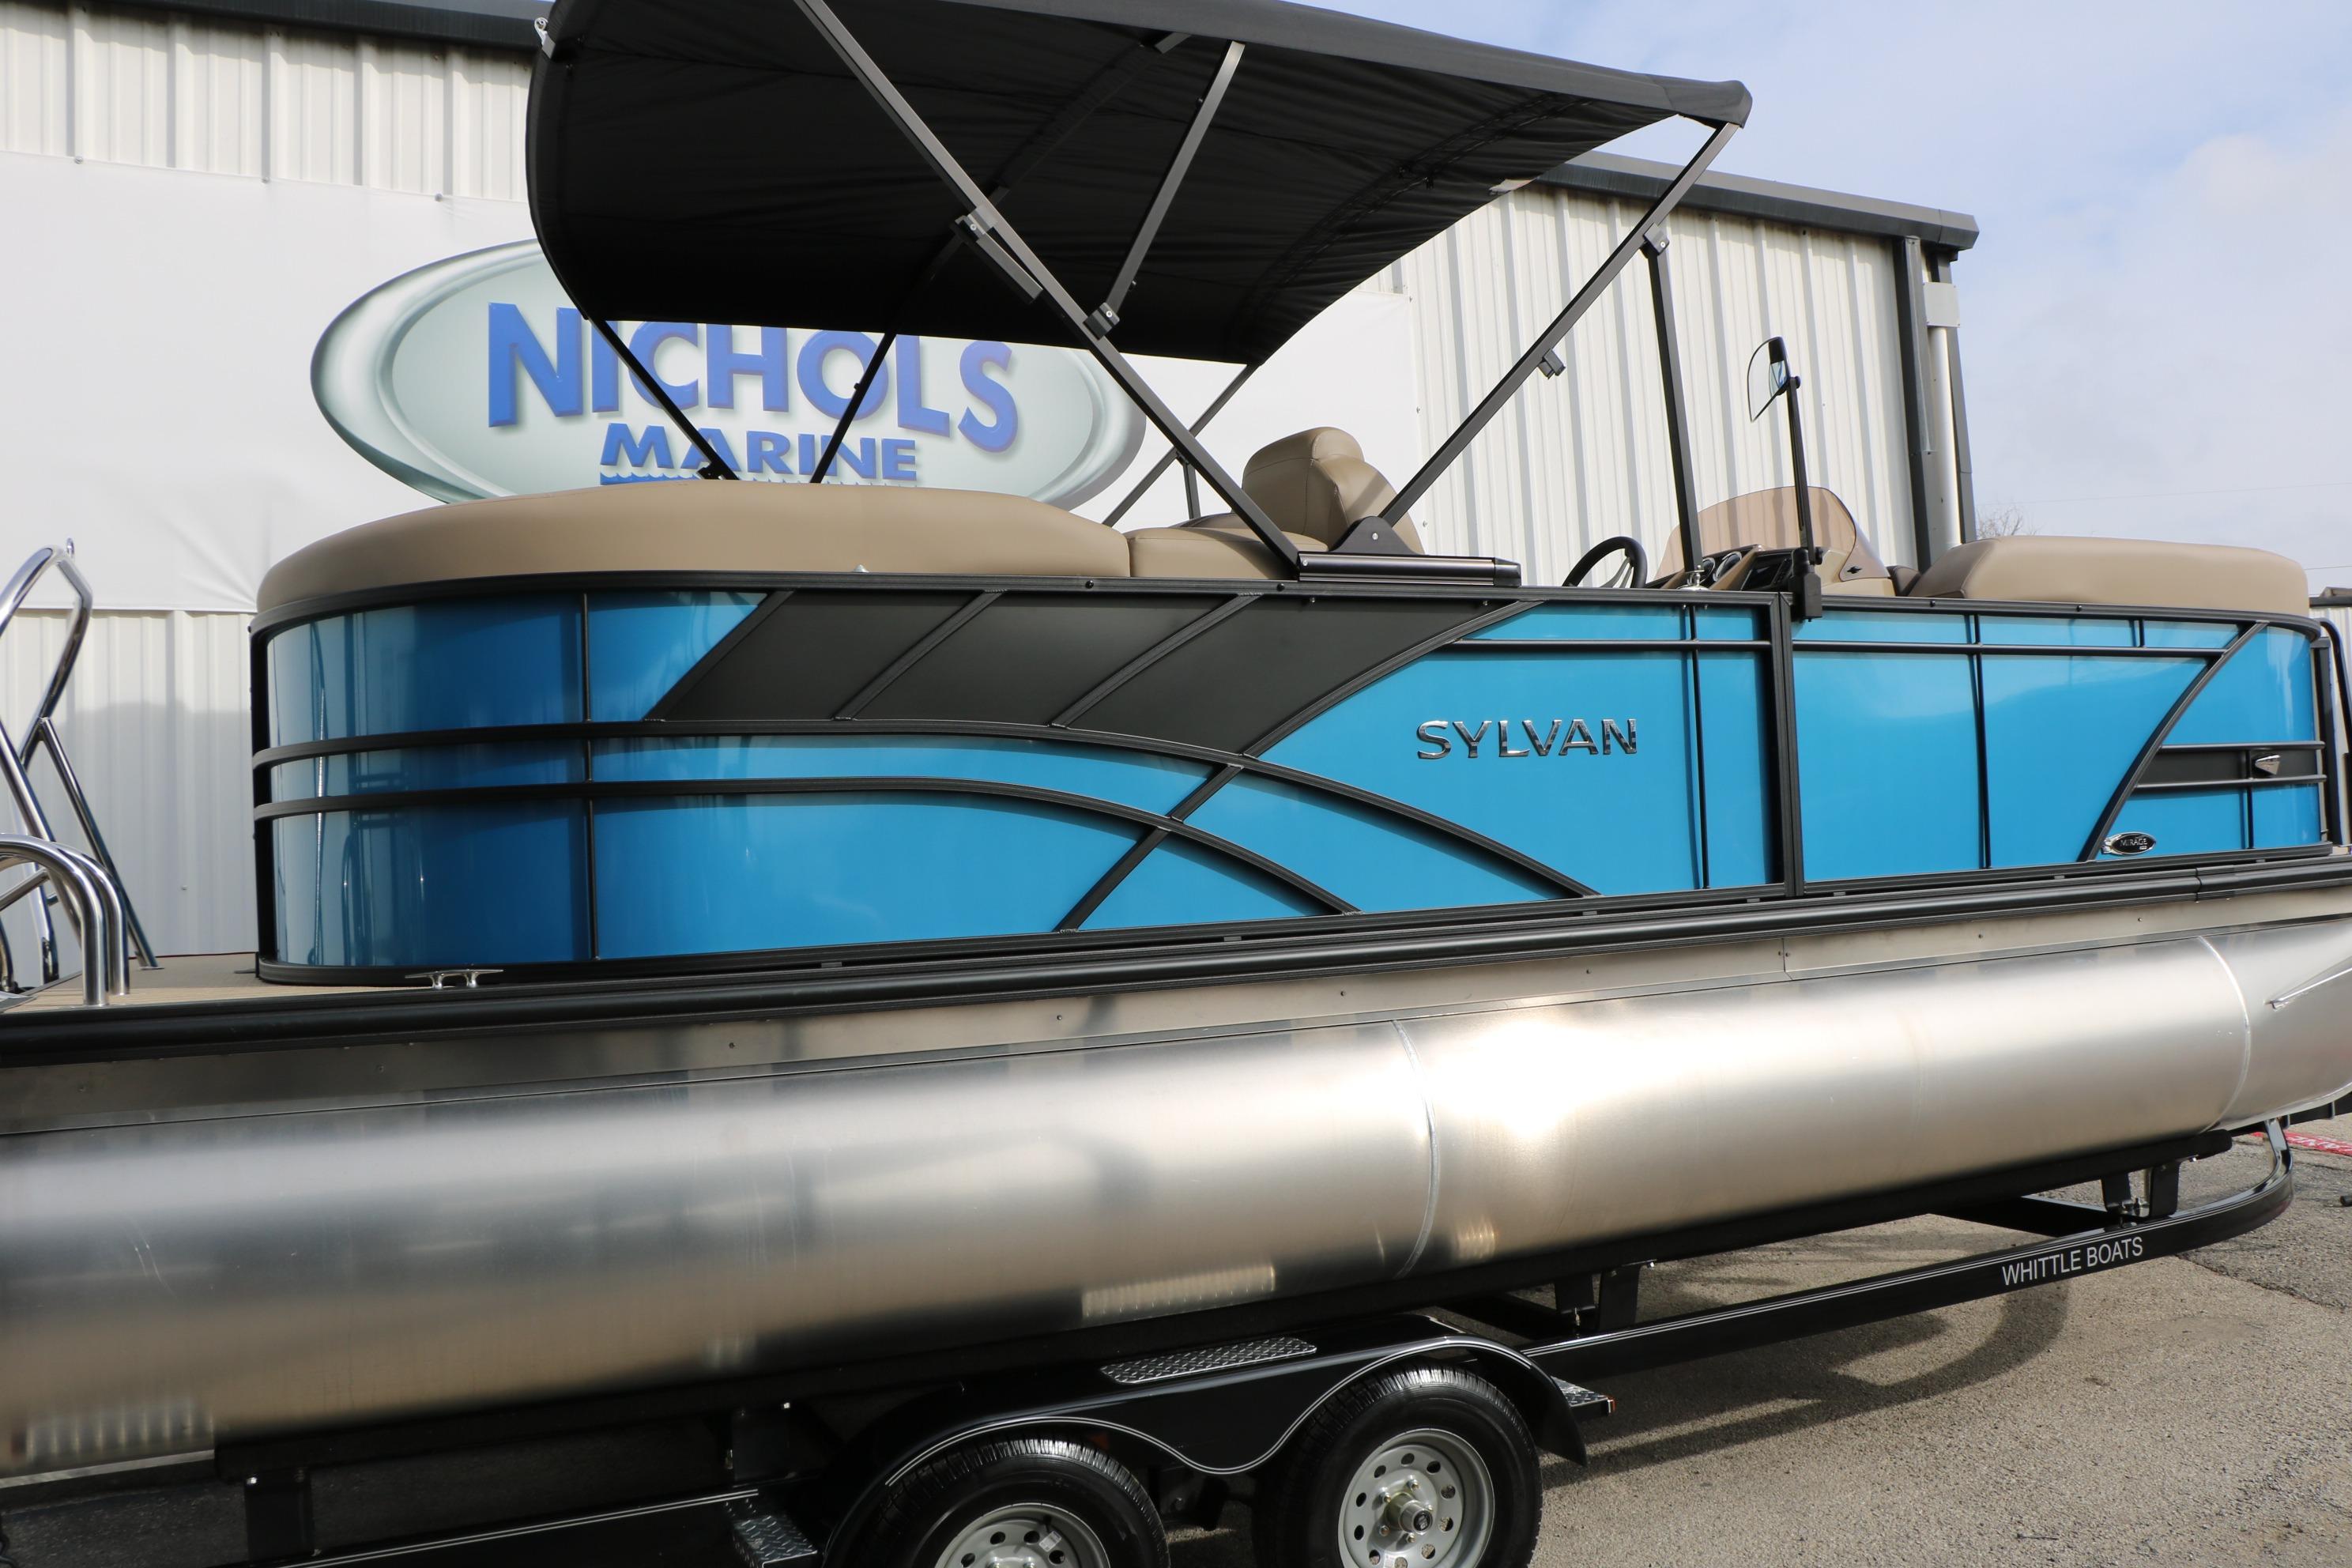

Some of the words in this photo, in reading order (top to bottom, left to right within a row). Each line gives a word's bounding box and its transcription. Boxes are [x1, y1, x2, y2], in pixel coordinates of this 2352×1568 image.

[488, 302, 1018, 453] NICHOLS
[600, 422, 918, 481] MARINE
[1416, 718, 1638, 760] SYLVAN
[2002, 1250, 2082, 1286] WHITTLE
[2086, 1236, 2143, 1267] BOATS
